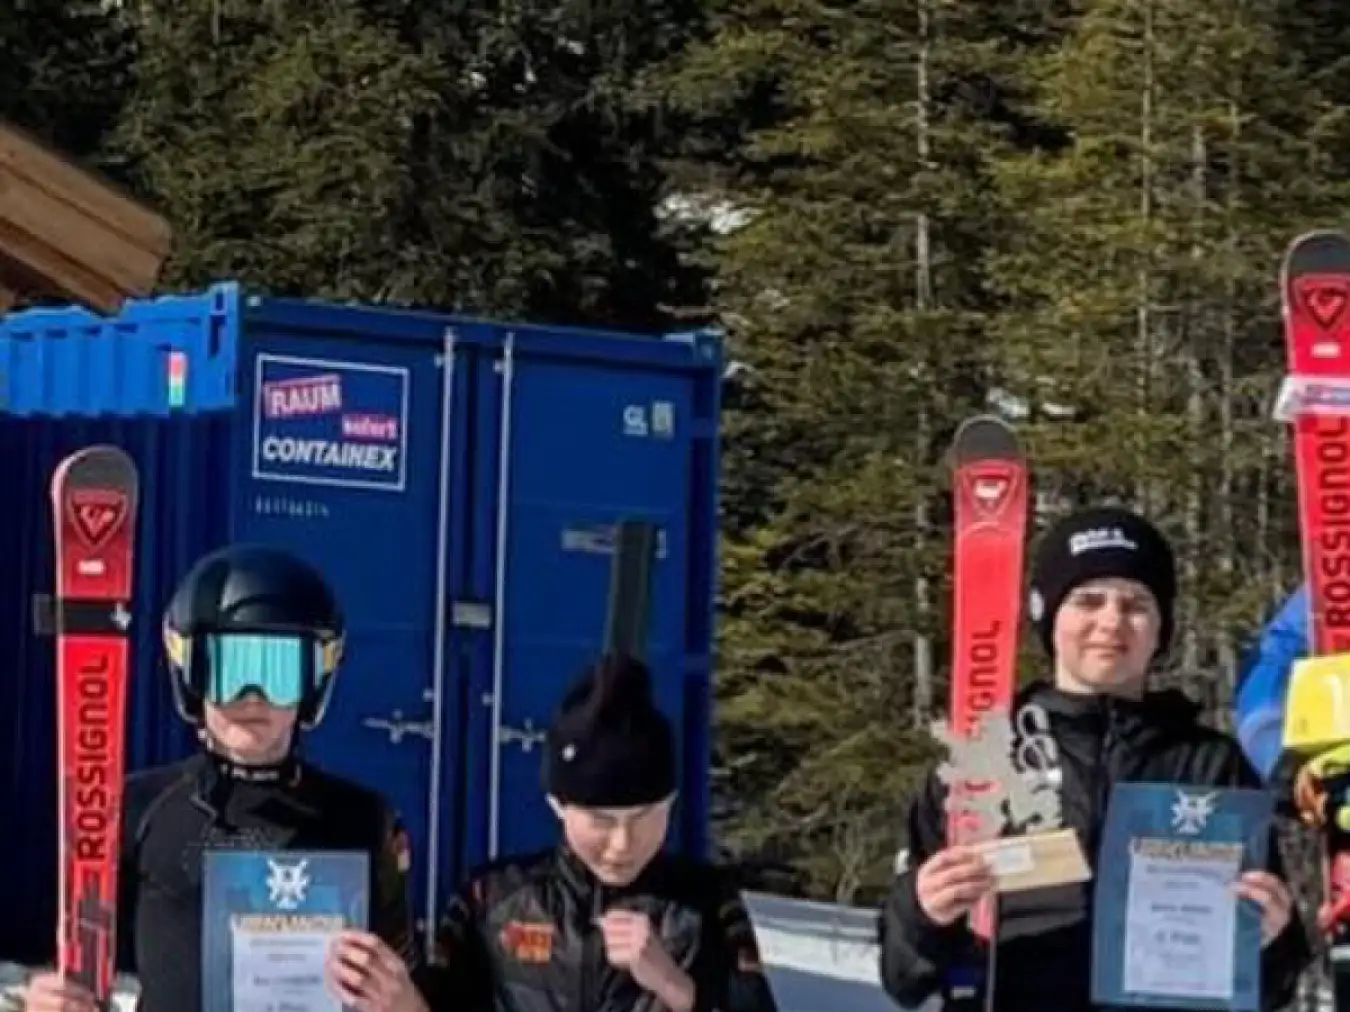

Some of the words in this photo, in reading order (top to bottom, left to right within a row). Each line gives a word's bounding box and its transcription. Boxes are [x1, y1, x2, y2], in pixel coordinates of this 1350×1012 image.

[270, 382, 342, 416] RAUM
[262, 436, 397, 472] CONTAINEX
[76, 654, 109, 861] ROSSIGNOL
